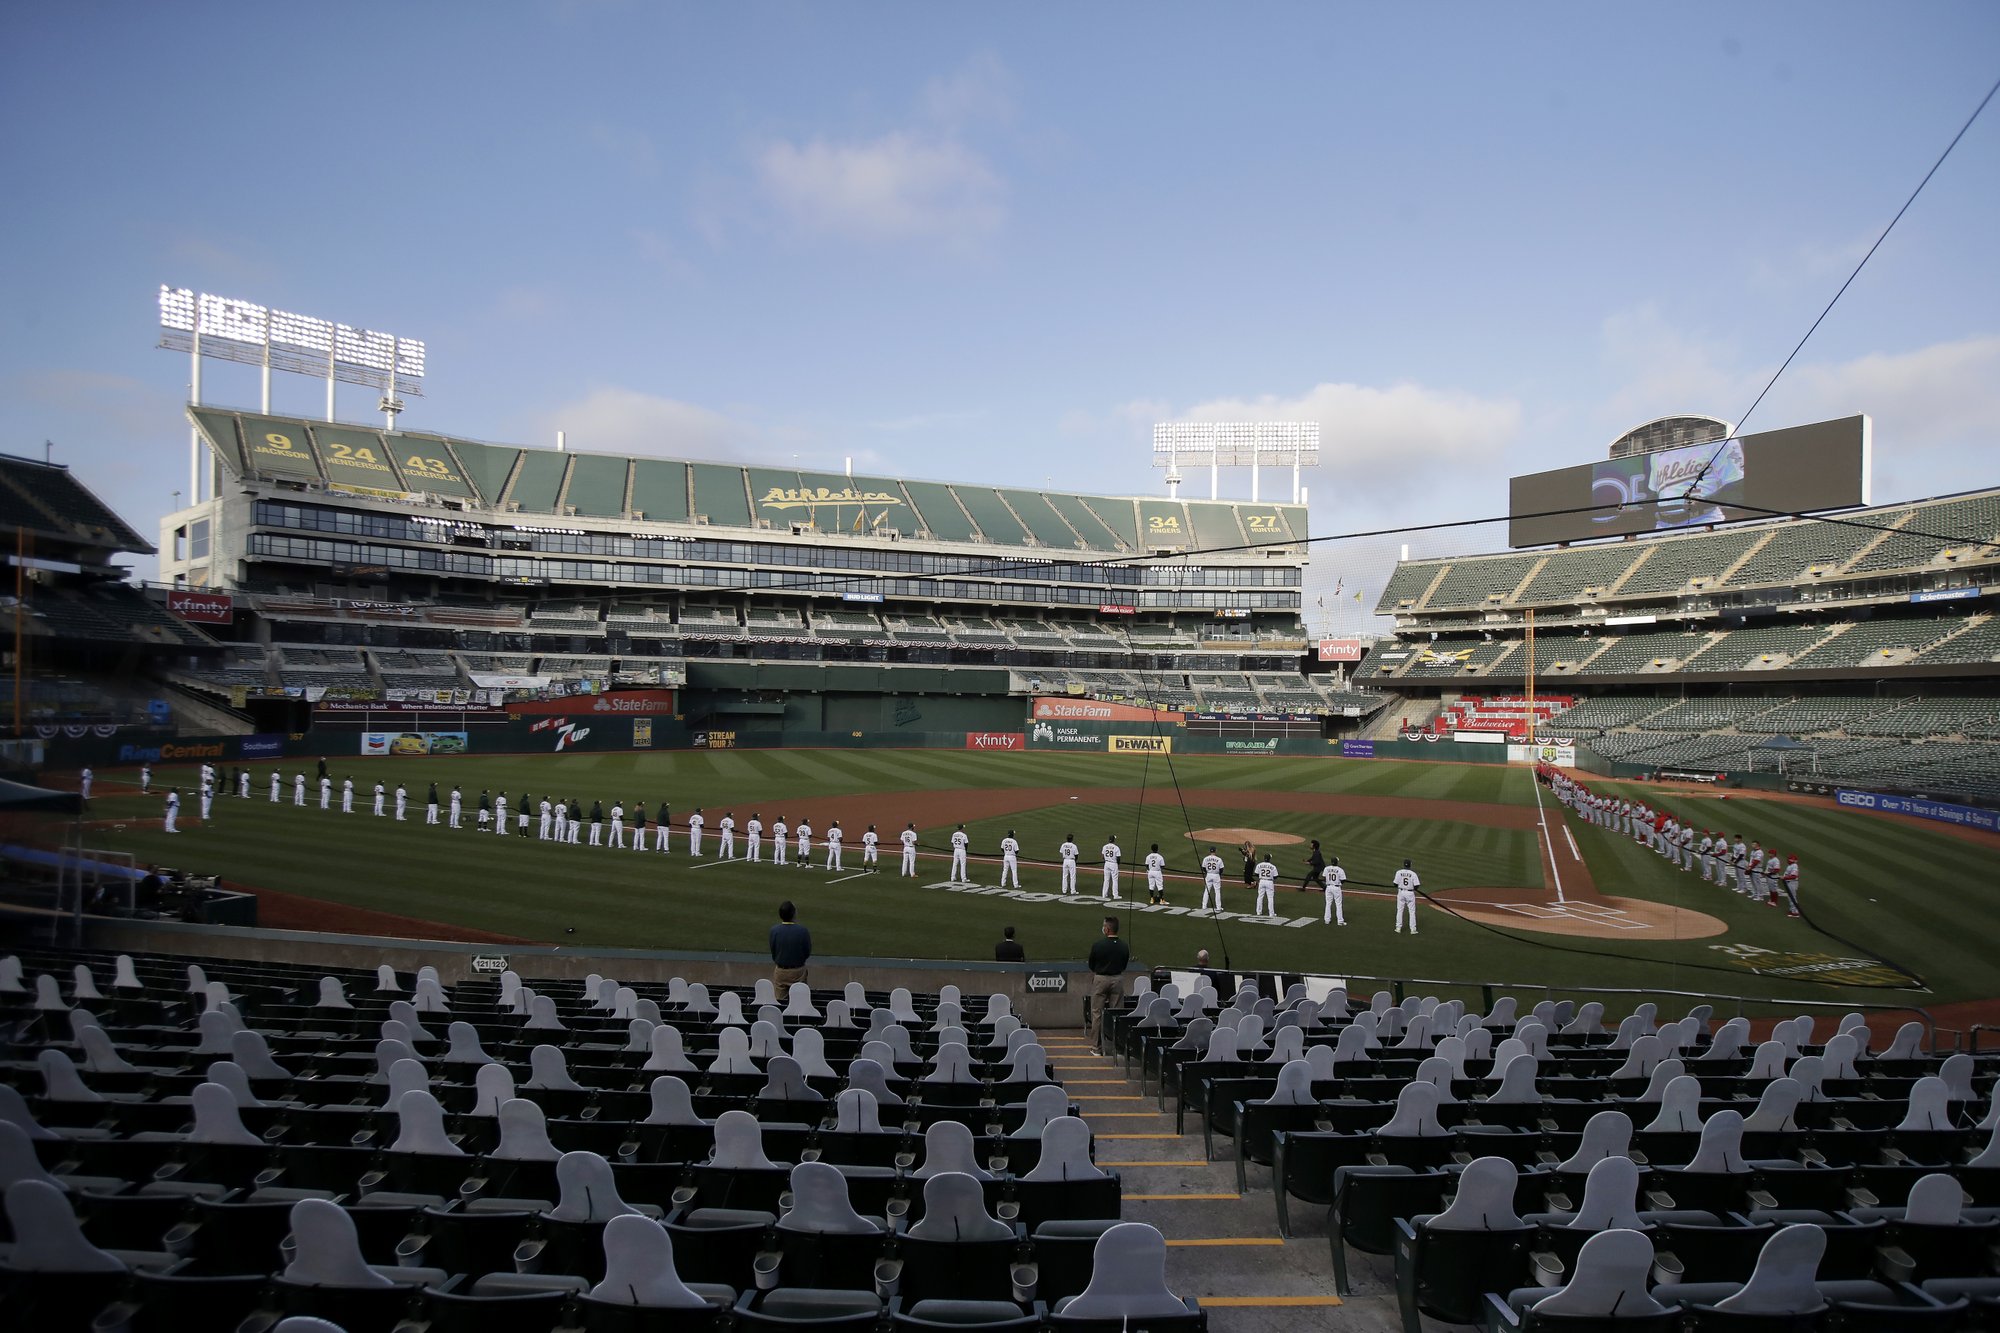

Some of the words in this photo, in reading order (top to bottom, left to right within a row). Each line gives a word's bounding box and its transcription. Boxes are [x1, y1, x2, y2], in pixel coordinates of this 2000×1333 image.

[265, 433, 292, 450] 9
[254, 446, 310, 460] JACKSON
[330, 443, 378, 464] 24
[326, 457, 391, 472] HENDERSON
[406, 456, 450, 474] 43
[404, 468, 462, 483] ECKERSLEY
[759, 487, 901, 508] Athletics
[1149, 516, 1179, 528] 34
[1247, 516, 1276, 528] 27
[1919, 591, 1969, 601] ticketmaster
[173, 598, 229, 618] xfinity
[1321, 643, 1358, 656] xfinity
[424, 703, 466, 711] Relationships
[1462, 718, 1515, 729] Budweiser
[709, 731, 736, 739] STREAM
[975, 733, 1016, 748] xfinity
[243, 742, 279, 751] Southwest
[709, 740, 726, 748] YOUR
[1543, 747, 1556, 757] 811
[1839, 792, 1875, 807] GEICO
[1882, 800, 1899, 810] Over
[1901, 801, 1911, 811] 75
[1913, 803, 1929, 815] Years
[1930, 806, 1938, 816] of
[1938, 808, 1964, 822] Savings
[1965, 811, 1972, 822] &
[1972, 812, 1992, 826] Service
[1105, 850, 1114, 858] 28
[1207, 862, 1217, 870] 26
[1261, 869, 1271, 878] 22
[1328, 873, 1337, 882] 10
[1403, 877, 1409, 886] 6
[922, 882, 1320, 928] RingCentral
[1708, 943, 1780, 957] 24
